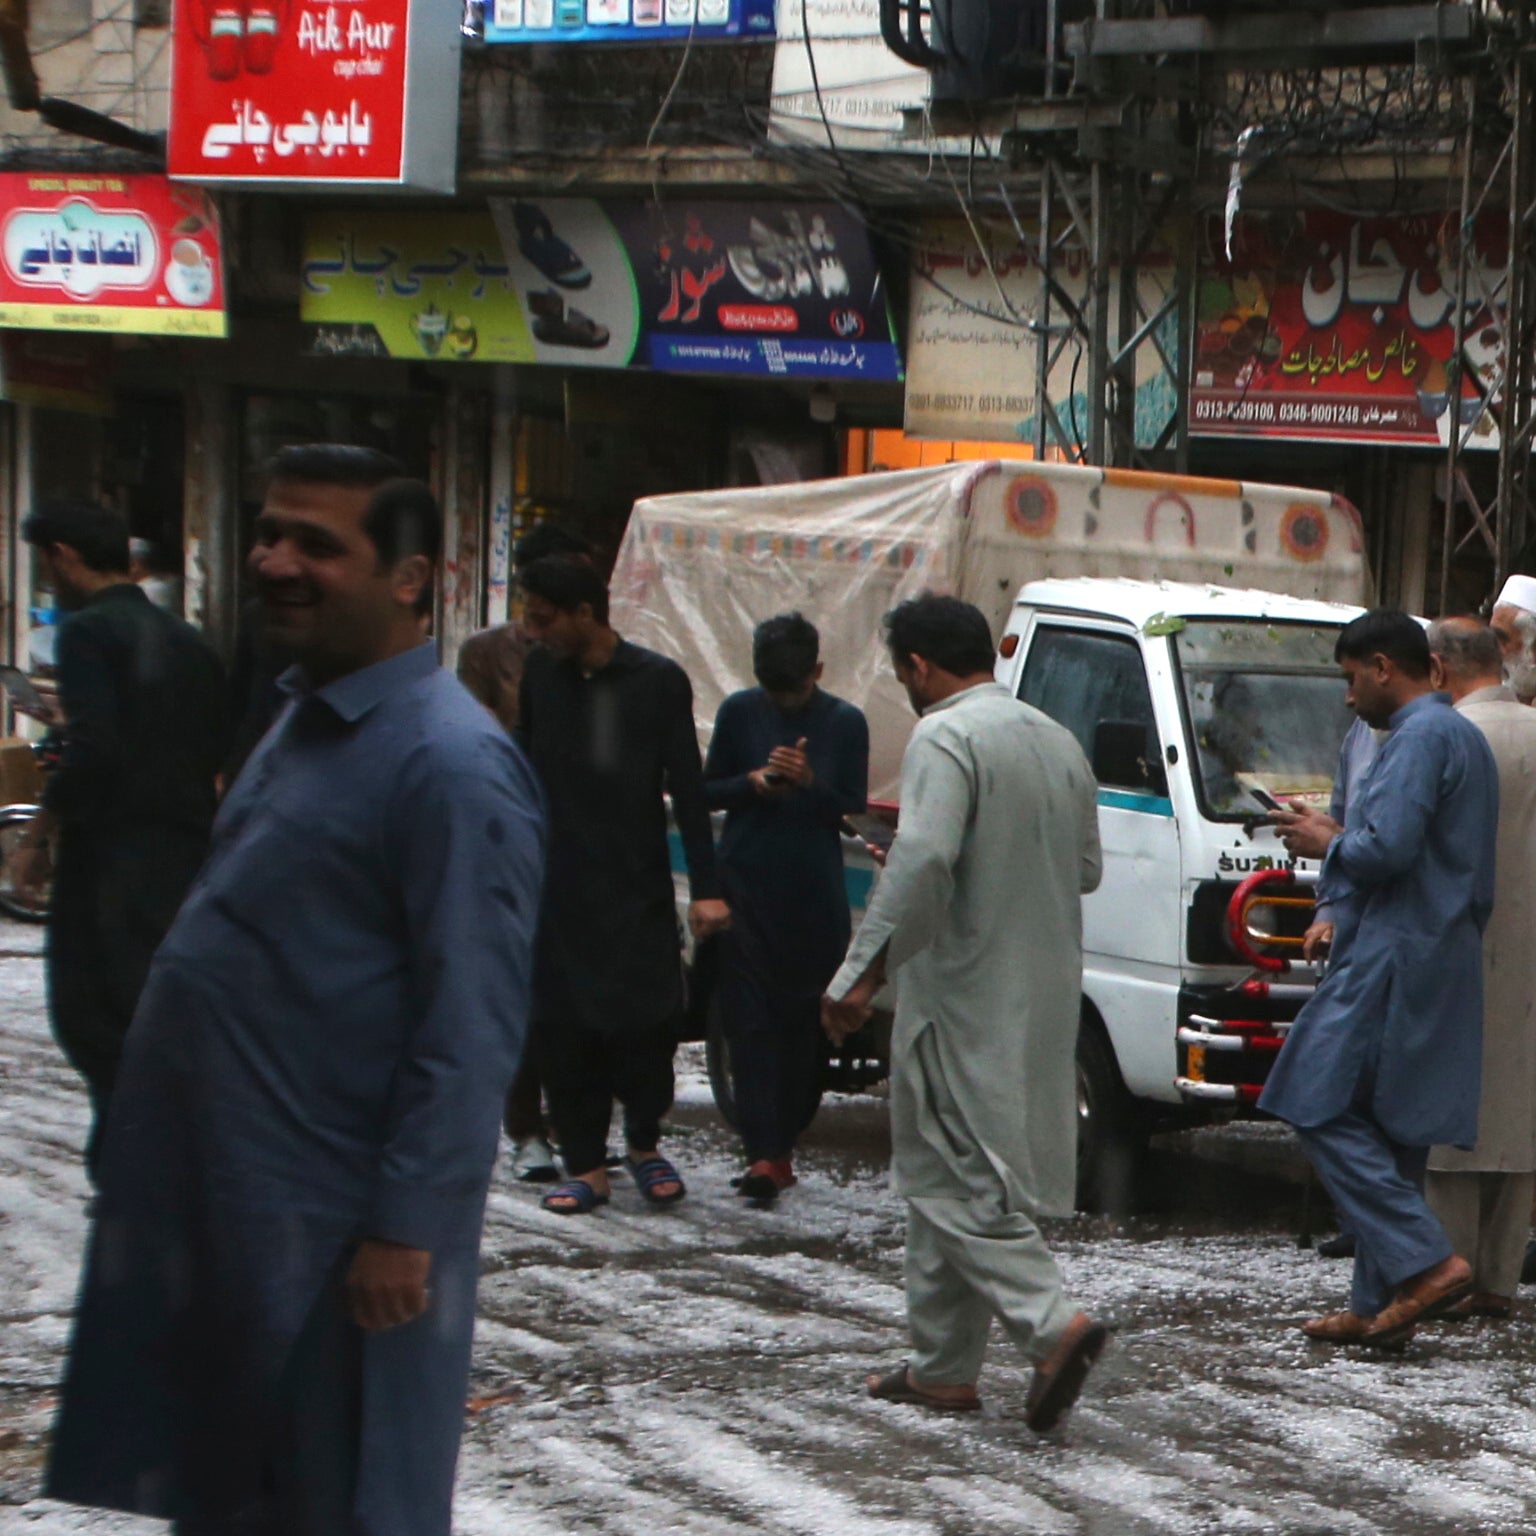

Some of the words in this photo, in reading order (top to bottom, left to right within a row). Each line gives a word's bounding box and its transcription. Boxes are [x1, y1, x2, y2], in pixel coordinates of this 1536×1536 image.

[296, 5, 342, 56] Aik
[347, 8, 396, 55] Aur
[19, 228, 74, 281] چائے
[77, 229, 141, 266] انصاف
[1301, 219, 1407, 329] جان
[1281, 342, 1323, 386] جات
[1367, 328, 1417, 383] خالص
